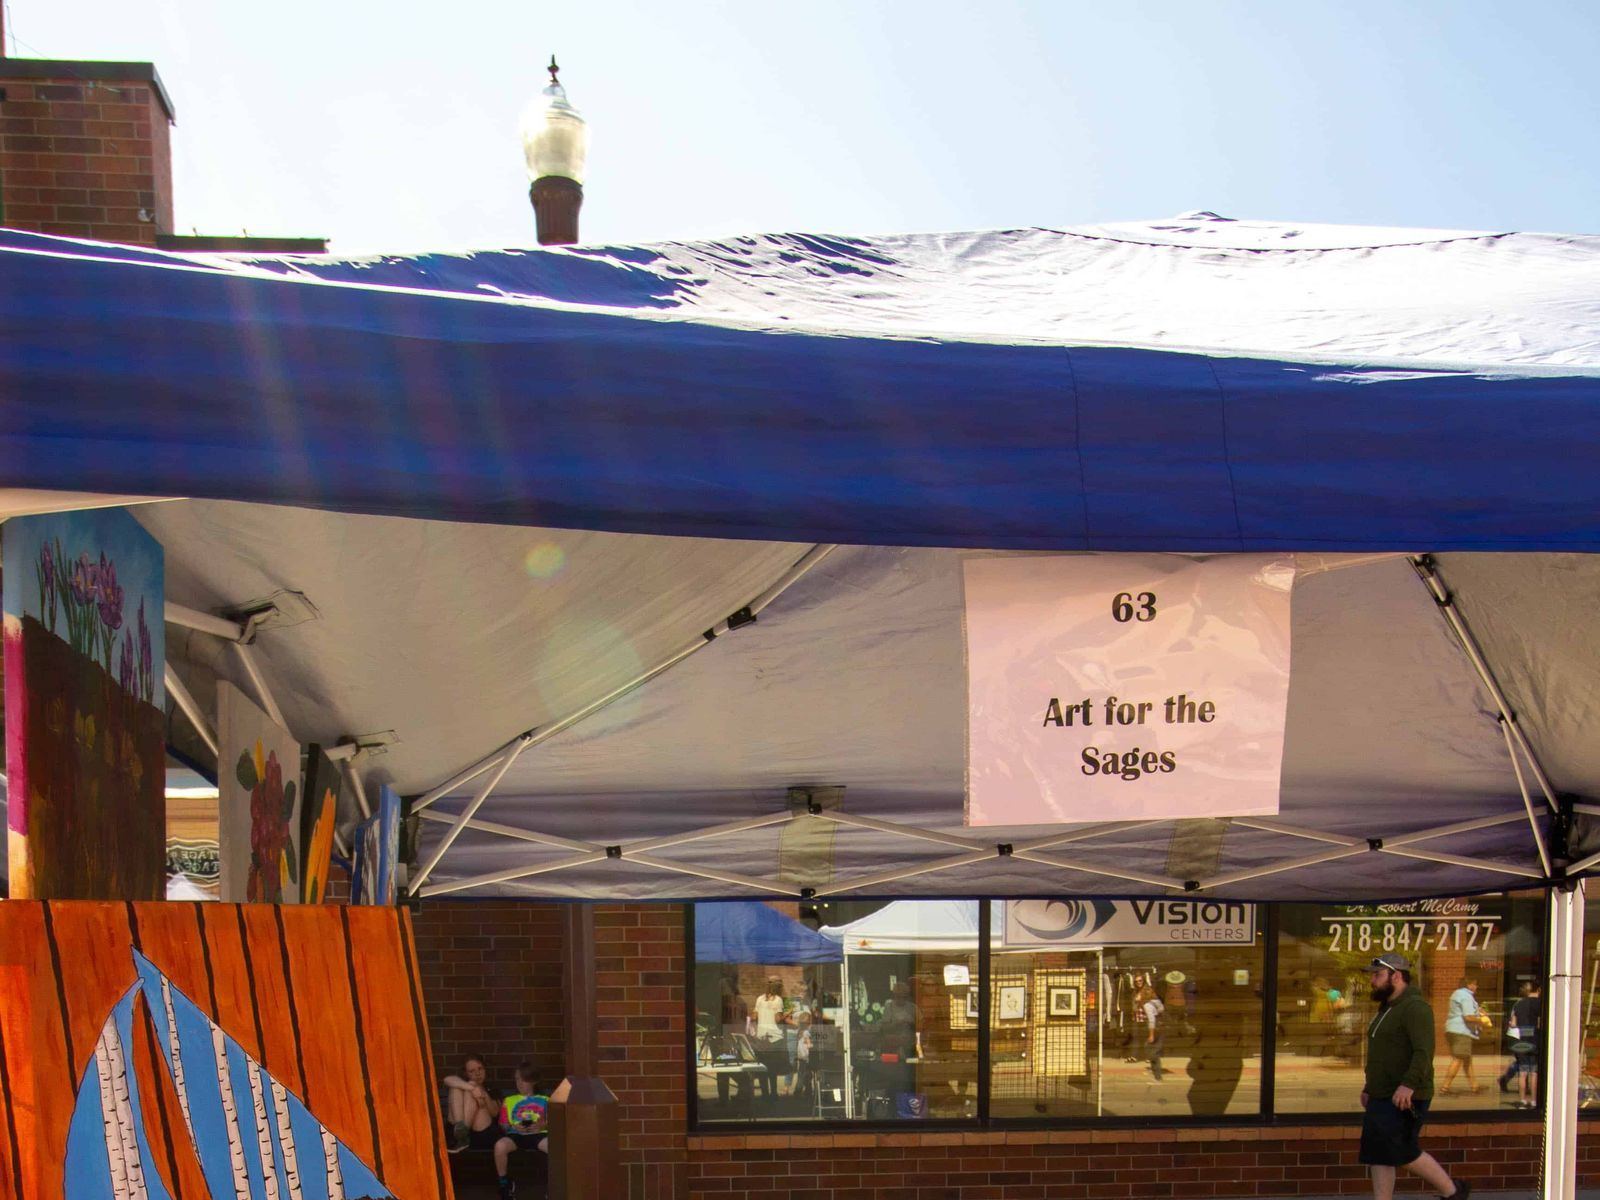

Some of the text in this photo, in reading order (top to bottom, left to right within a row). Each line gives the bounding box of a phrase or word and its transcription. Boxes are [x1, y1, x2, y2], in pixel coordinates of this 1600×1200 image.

[1111, 592, 1157, 622] 63
[1043, 694, 1216, 727] Art for the
[1081, 747, 1176, 781] Sages
[1130, 900, 1245, 924] Vision
[1419, 897, 1480, 915] McCamy
[1170, 928, 1244, 939] CENTERS
[1328, 922, 1494, 952] 218-847-2127
